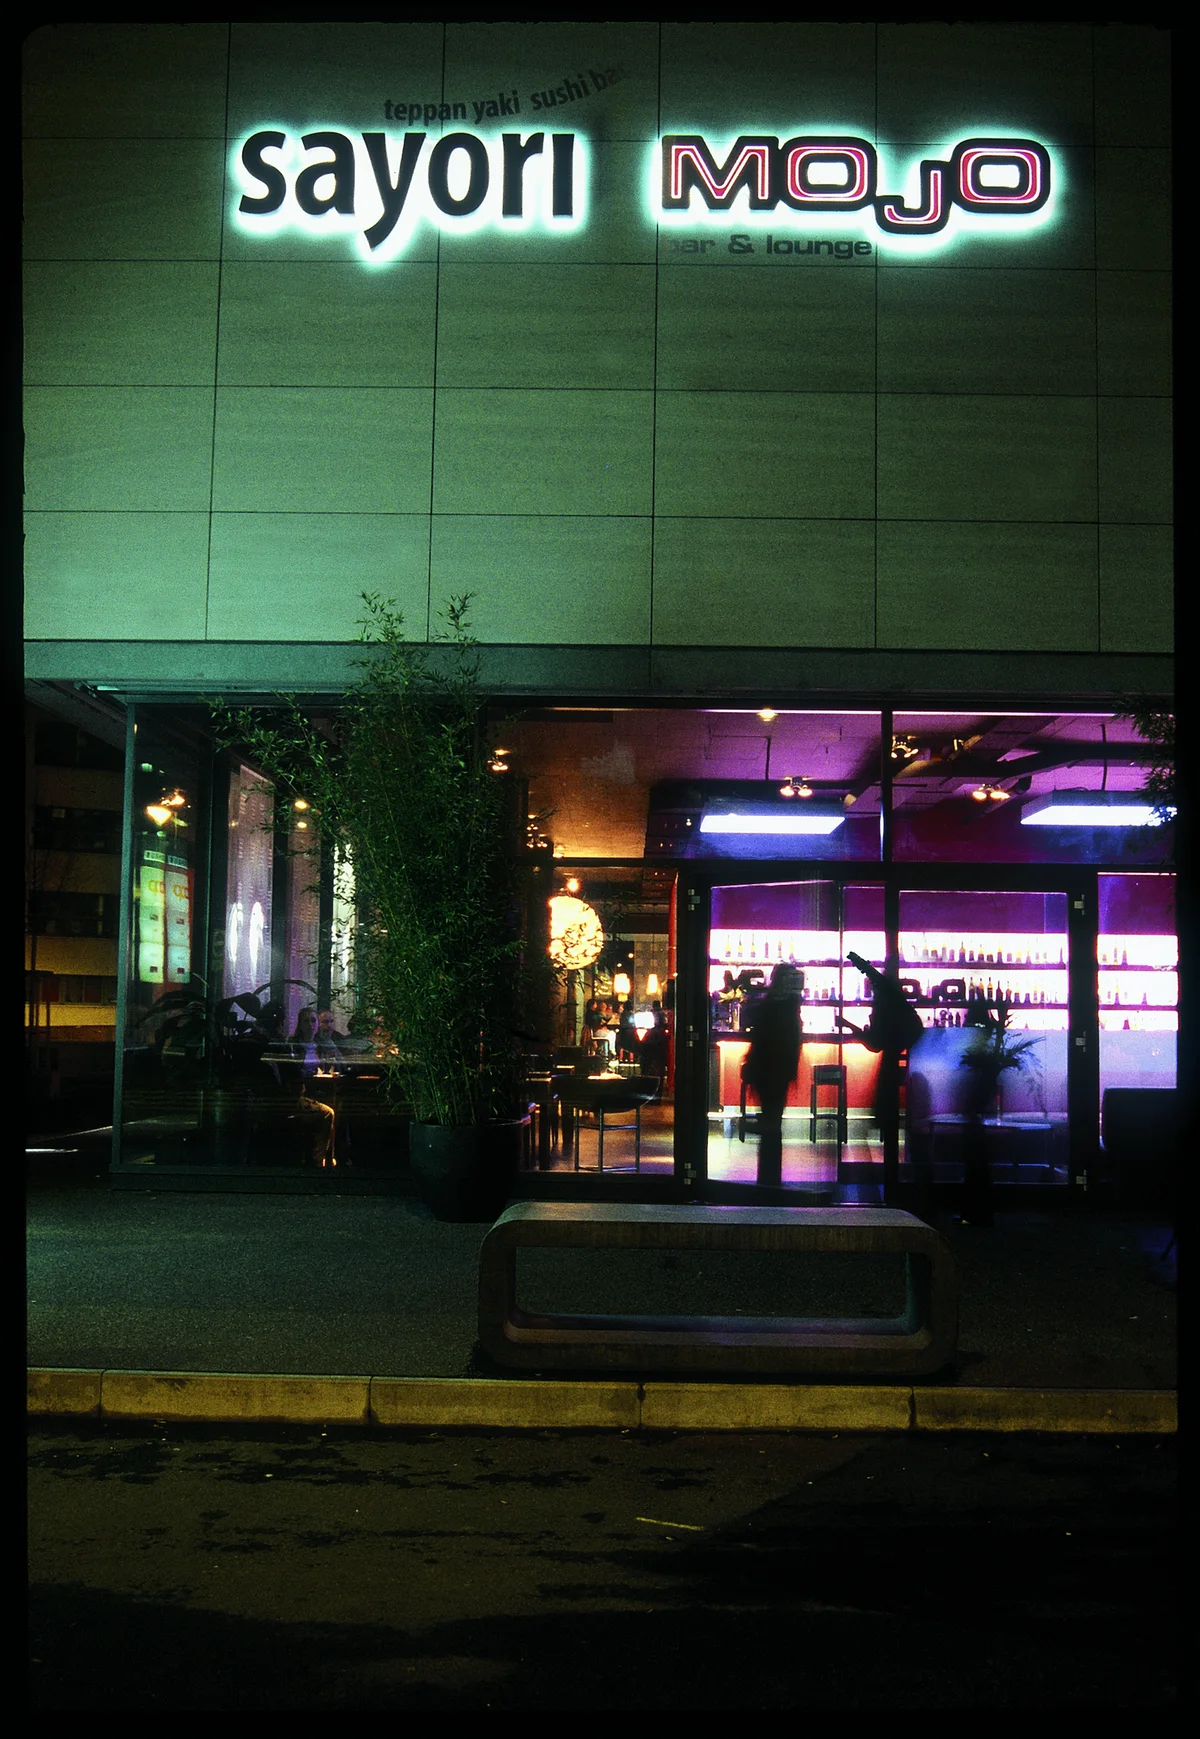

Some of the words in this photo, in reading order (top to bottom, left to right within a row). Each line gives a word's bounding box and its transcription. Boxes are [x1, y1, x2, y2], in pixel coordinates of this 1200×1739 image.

[384, 99, 467, 126] teppan
[472, 90, 521, 125] yaki
[530, 73, 590, 111] sushi
[239, 130, 575, 252] sayori
[662, 136, 1051, 235] MOJO
[727, 234, 755, 255] &
[766, 234, 873, 260] lounge
